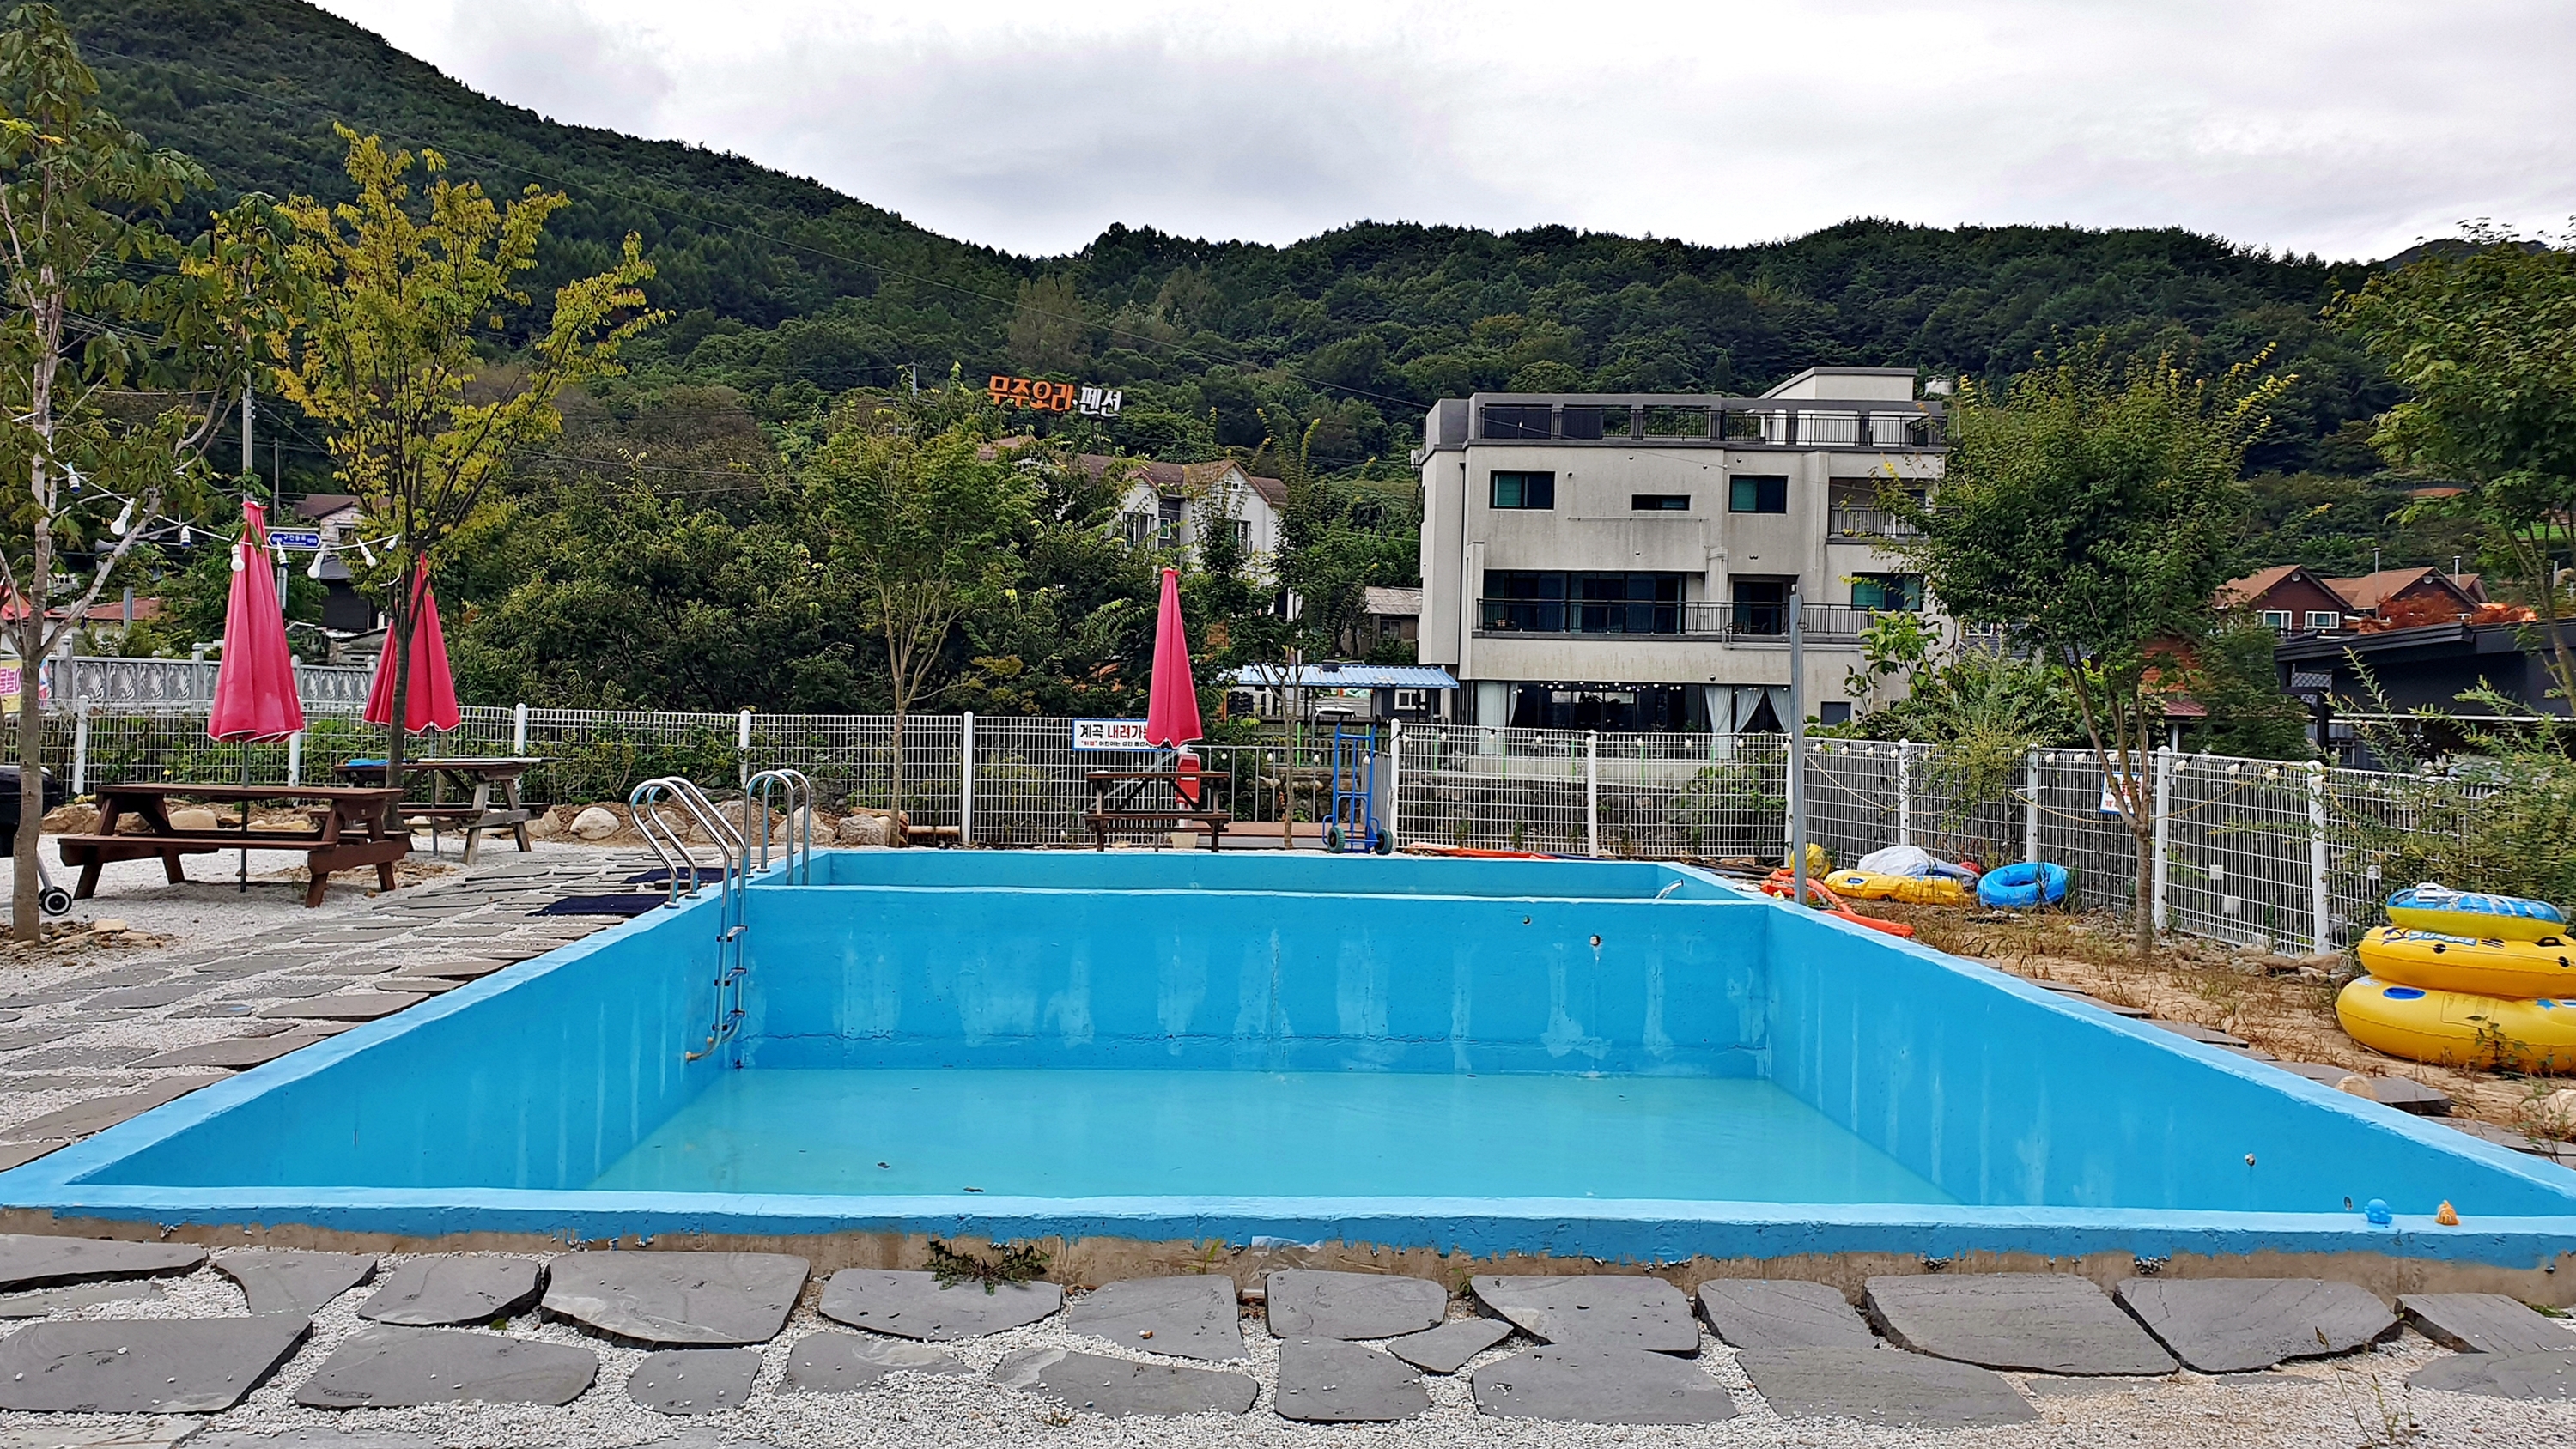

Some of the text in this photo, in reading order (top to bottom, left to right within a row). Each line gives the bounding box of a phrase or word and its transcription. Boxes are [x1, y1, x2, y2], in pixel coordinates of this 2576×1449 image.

[987, 375, 1122, 418] 무주오리 펜션
[1080, 724, 1103, 739] 계곡
